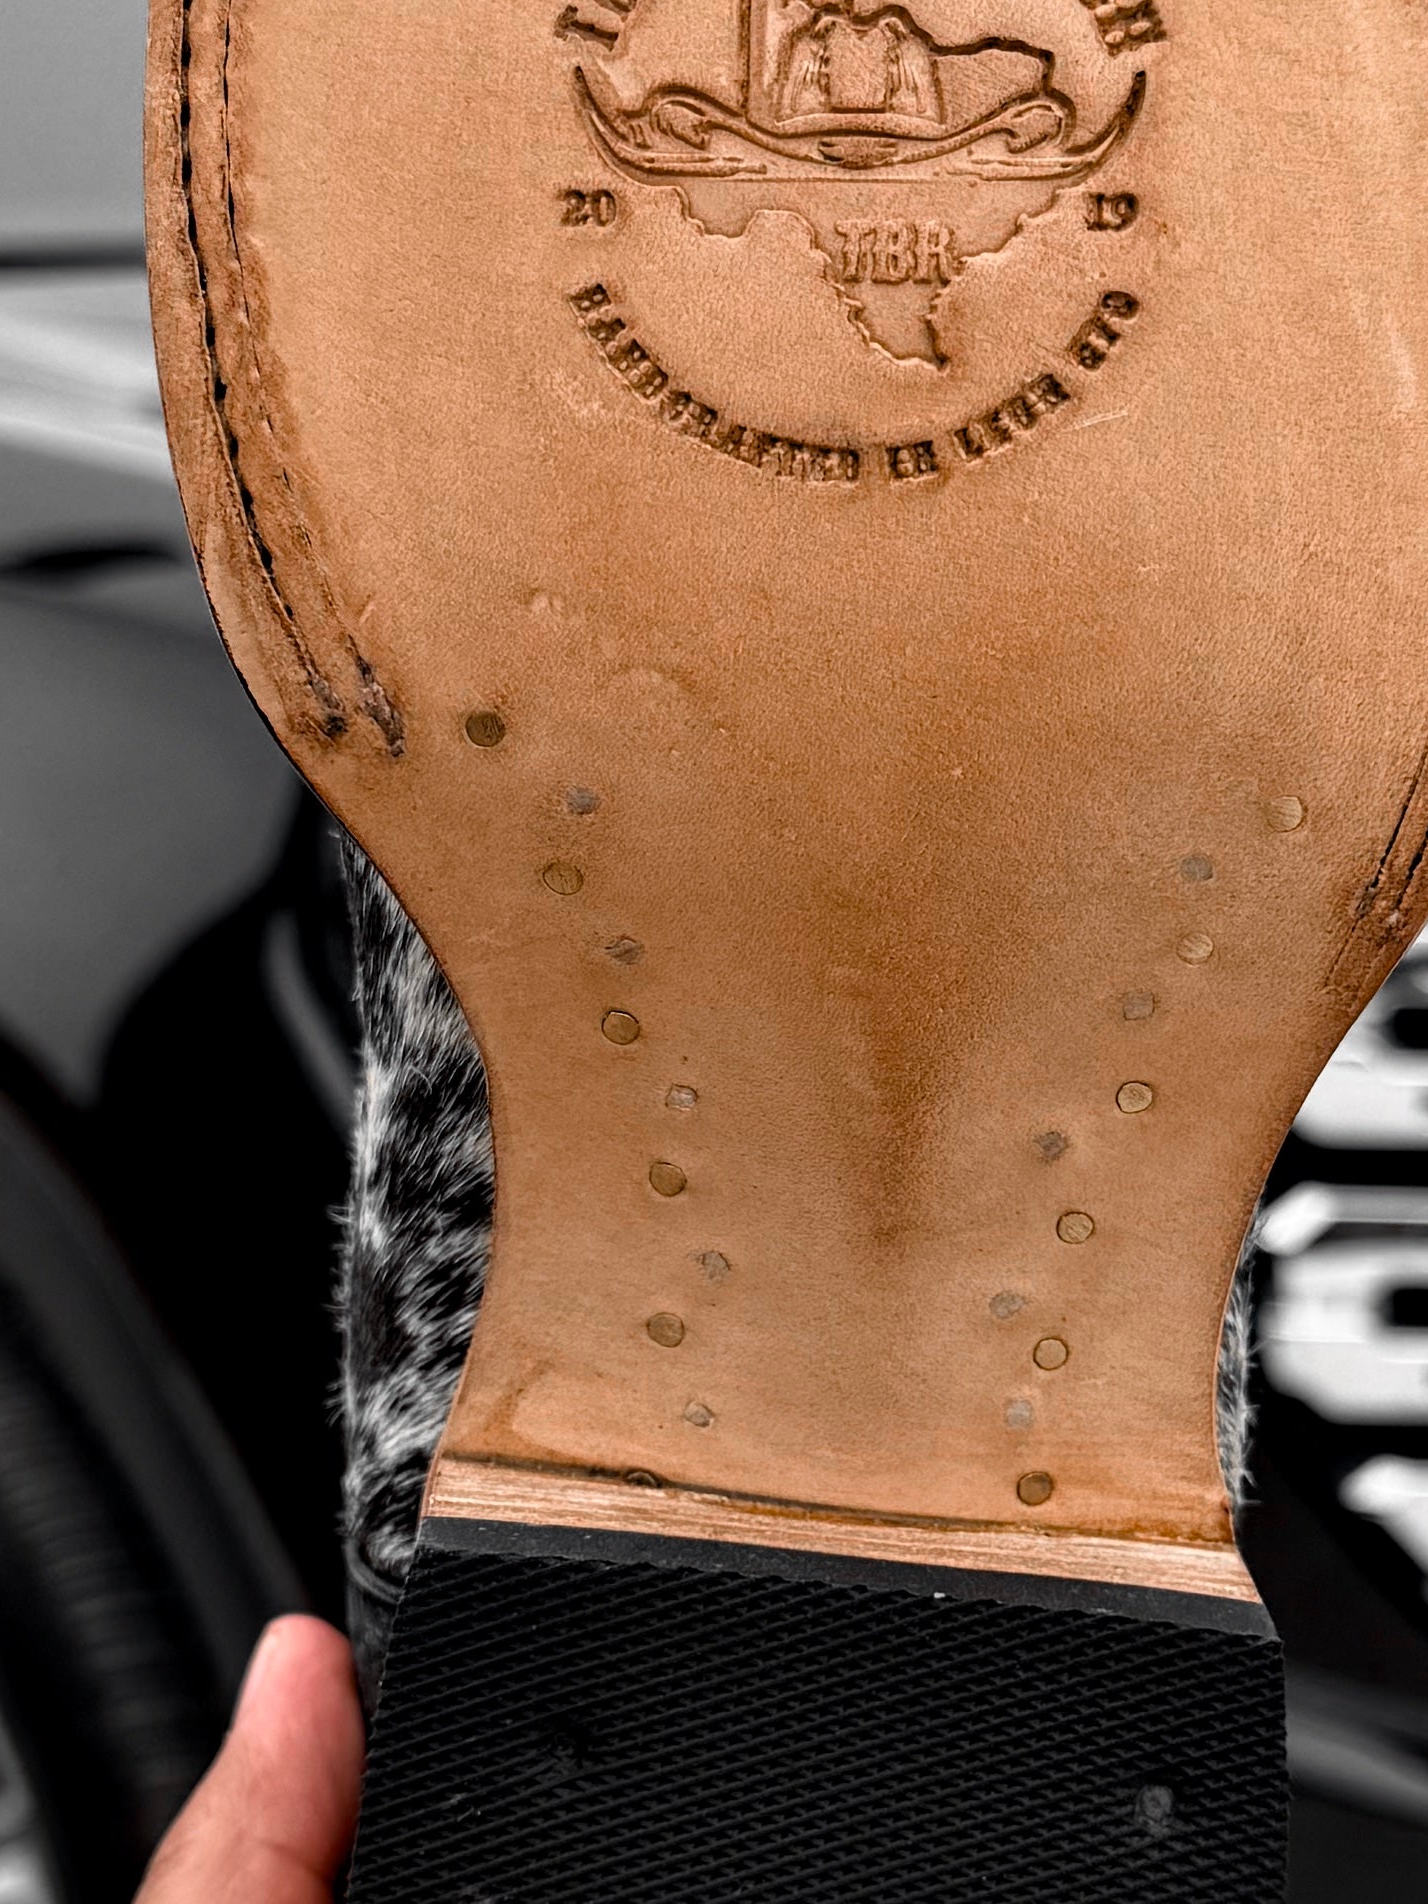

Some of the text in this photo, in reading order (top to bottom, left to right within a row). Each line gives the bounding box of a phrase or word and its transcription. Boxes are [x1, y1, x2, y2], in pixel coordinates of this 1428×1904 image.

[559, 188, 616, 228] 20
[1085, 192, 1139, 232] 19
[834, 218, 954, 286] TBR
